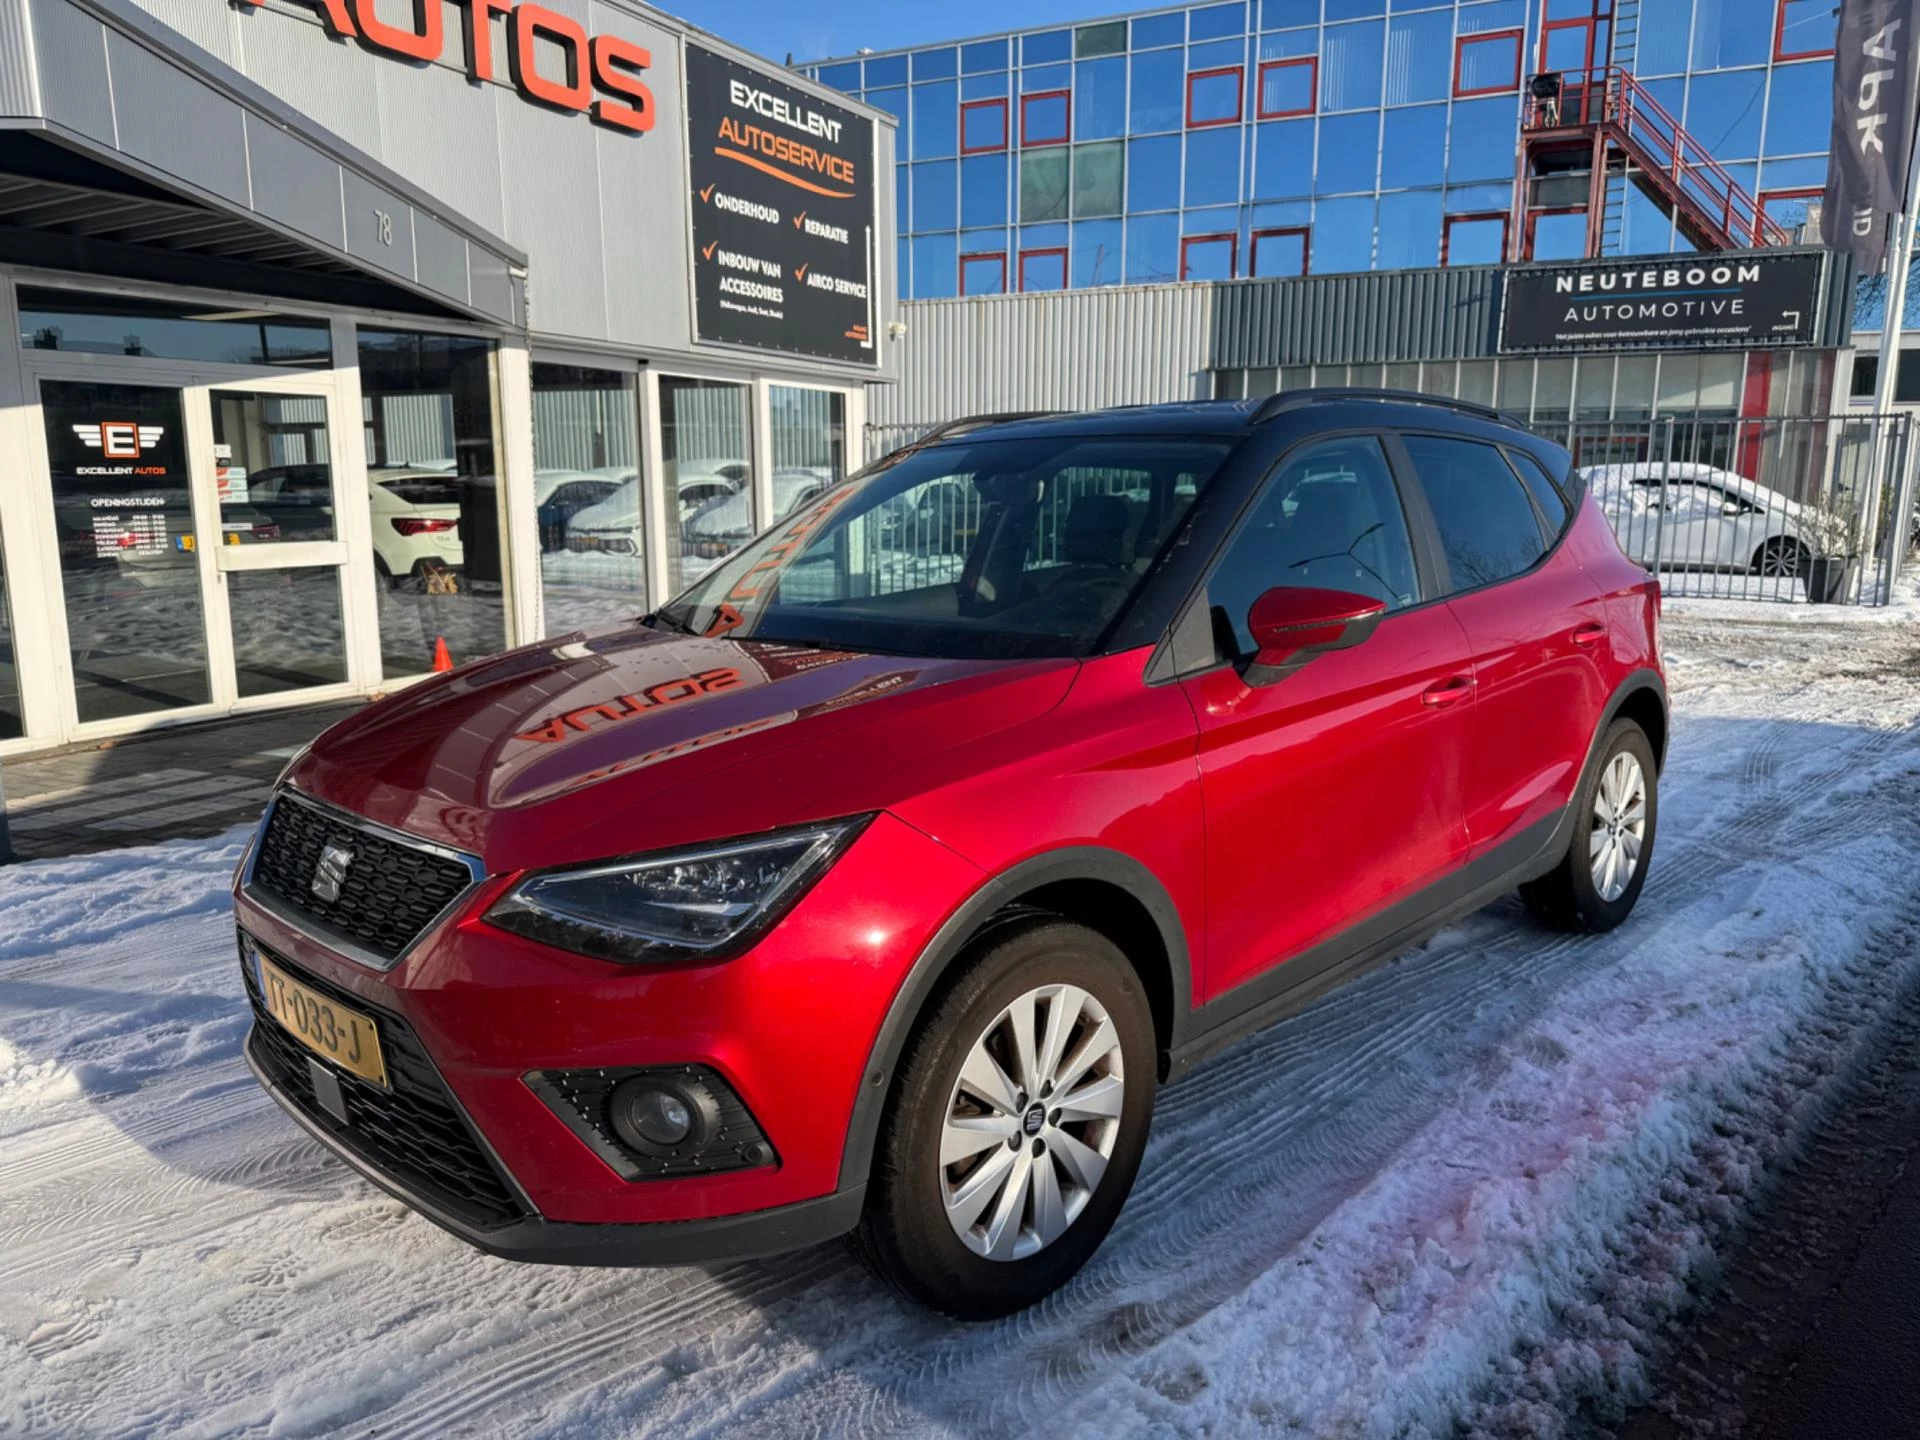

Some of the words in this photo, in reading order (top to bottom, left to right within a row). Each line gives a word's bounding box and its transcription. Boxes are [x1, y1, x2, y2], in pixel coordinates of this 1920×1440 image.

[243, 0, 656, 132] UTOS
[729, 79, 842, 143] EXCELLENT
[718, 116, 855, 184] AUTOSERVICE
[714, 191, 780, 224] ONDERHOUD
[373, 209, 393, 247] 78
[805, 218, 849, 244] REPARATIE
[717, 250, 760, 275] INBOUW
[761, 260, 782, 279] VAN
[1555, 264, 1761, 293] NEUTEBOOM
[718, 277, 784, 303] ACCESSOIRES
[806, 272, 834, 292] AIRCO
[834, 277, 867, 299] SERVICE
[1563, 299, 1745, 322] AUTOMOTIVE
[76, 466, 133, 475] EXCELLENT
[134, 466, 167, 475] AUTOS
